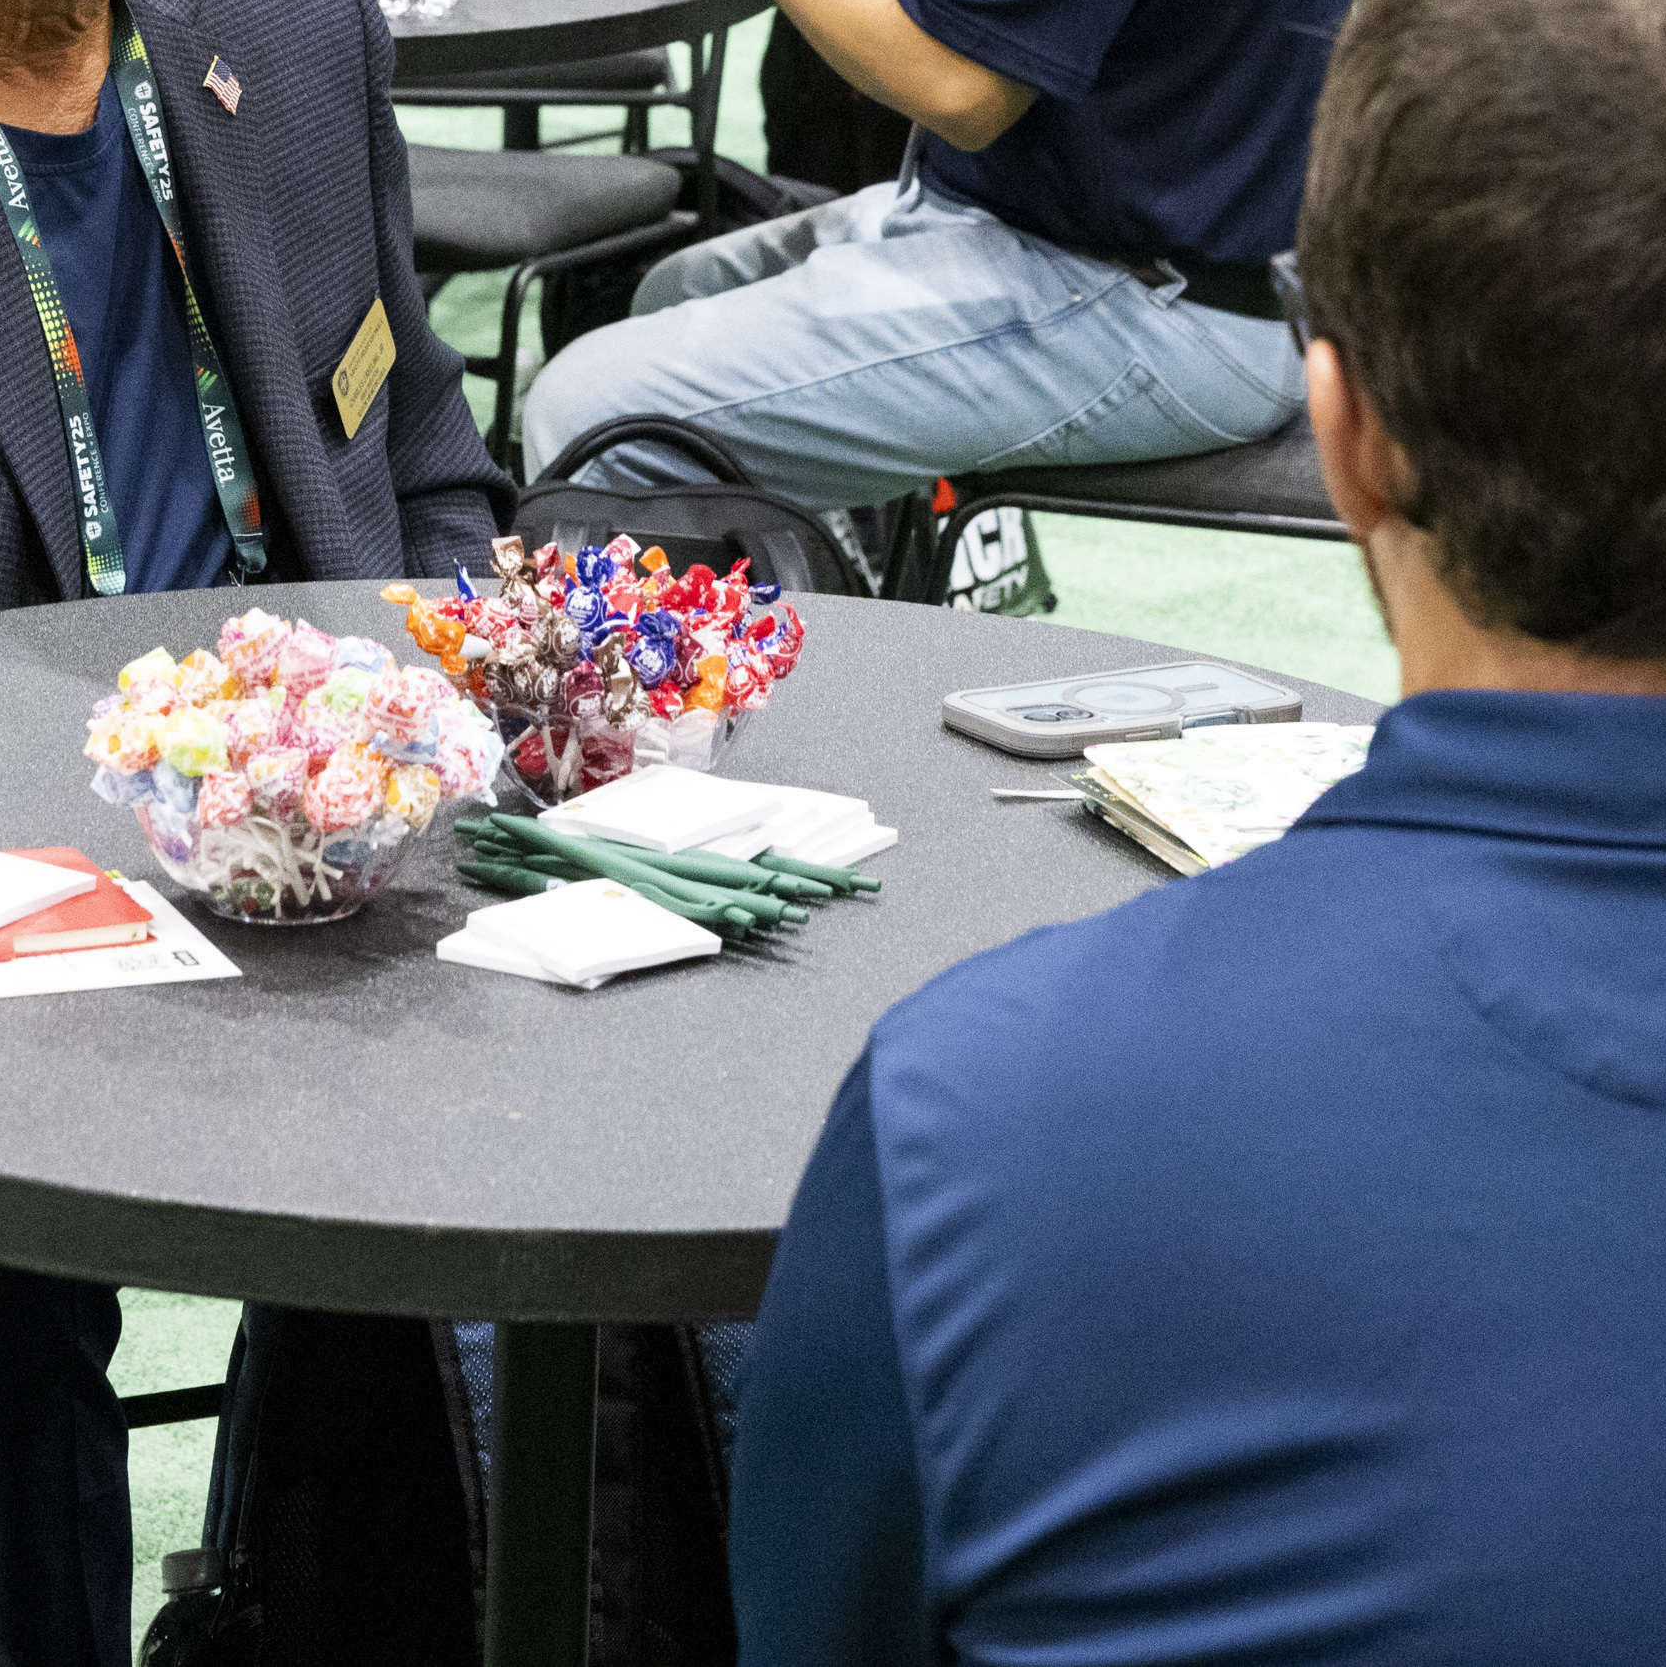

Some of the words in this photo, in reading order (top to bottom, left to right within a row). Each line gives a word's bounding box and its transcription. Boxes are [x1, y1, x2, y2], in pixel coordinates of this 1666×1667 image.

[127, 107, 154, 169] CONFERENCE
[151, 178, 163, 203] EXPO
[139, 101, 174, 202] SAFETY25
[69, 415, 99, 518] SAFETY25
[82, 412, 94, 438] EXPO
[202, 402, 236, 484] Avetta
[90, 449, 109, 513] CONFERENCE
